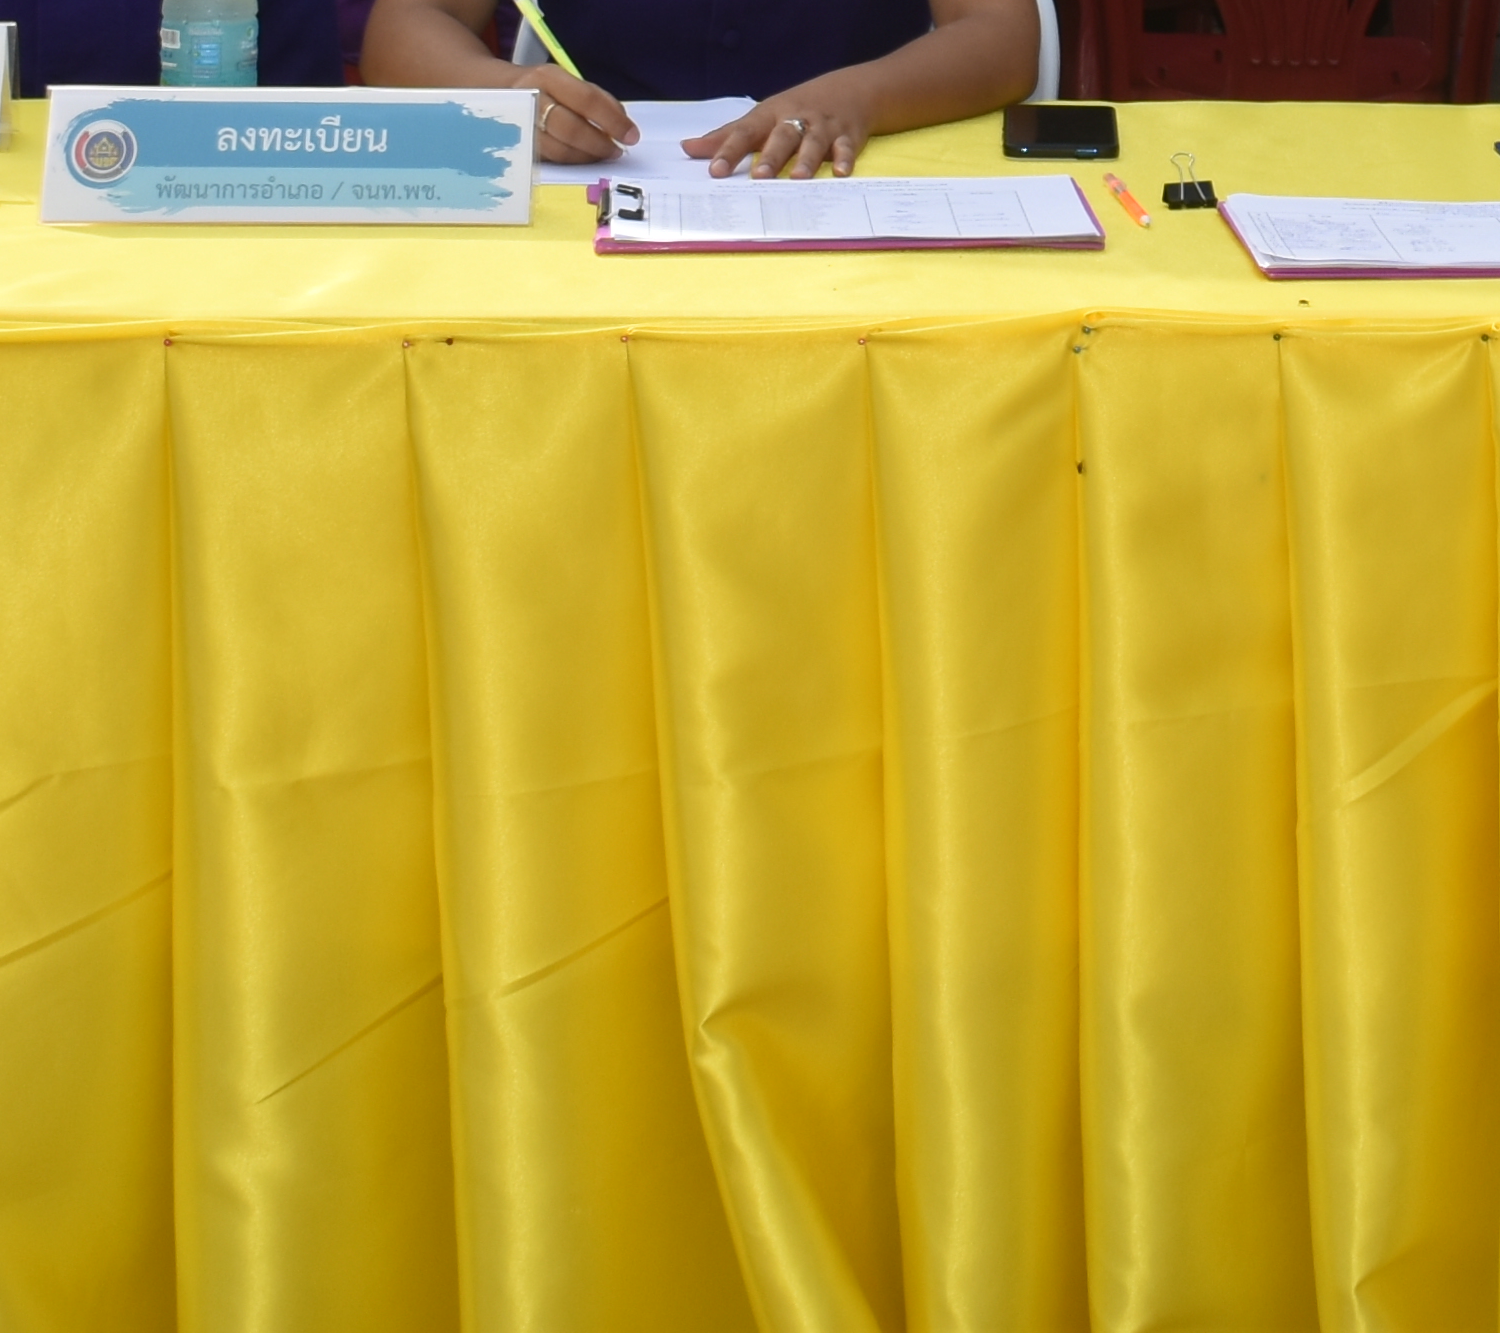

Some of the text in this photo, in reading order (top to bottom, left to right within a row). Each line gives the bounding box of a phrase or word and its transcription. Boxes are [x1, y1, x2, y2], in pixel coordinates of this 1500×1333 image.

[217, 115, 387, 152] ลงทะเบียน
[156, 175, 323, 200] พัฒนาการอำเภอ
